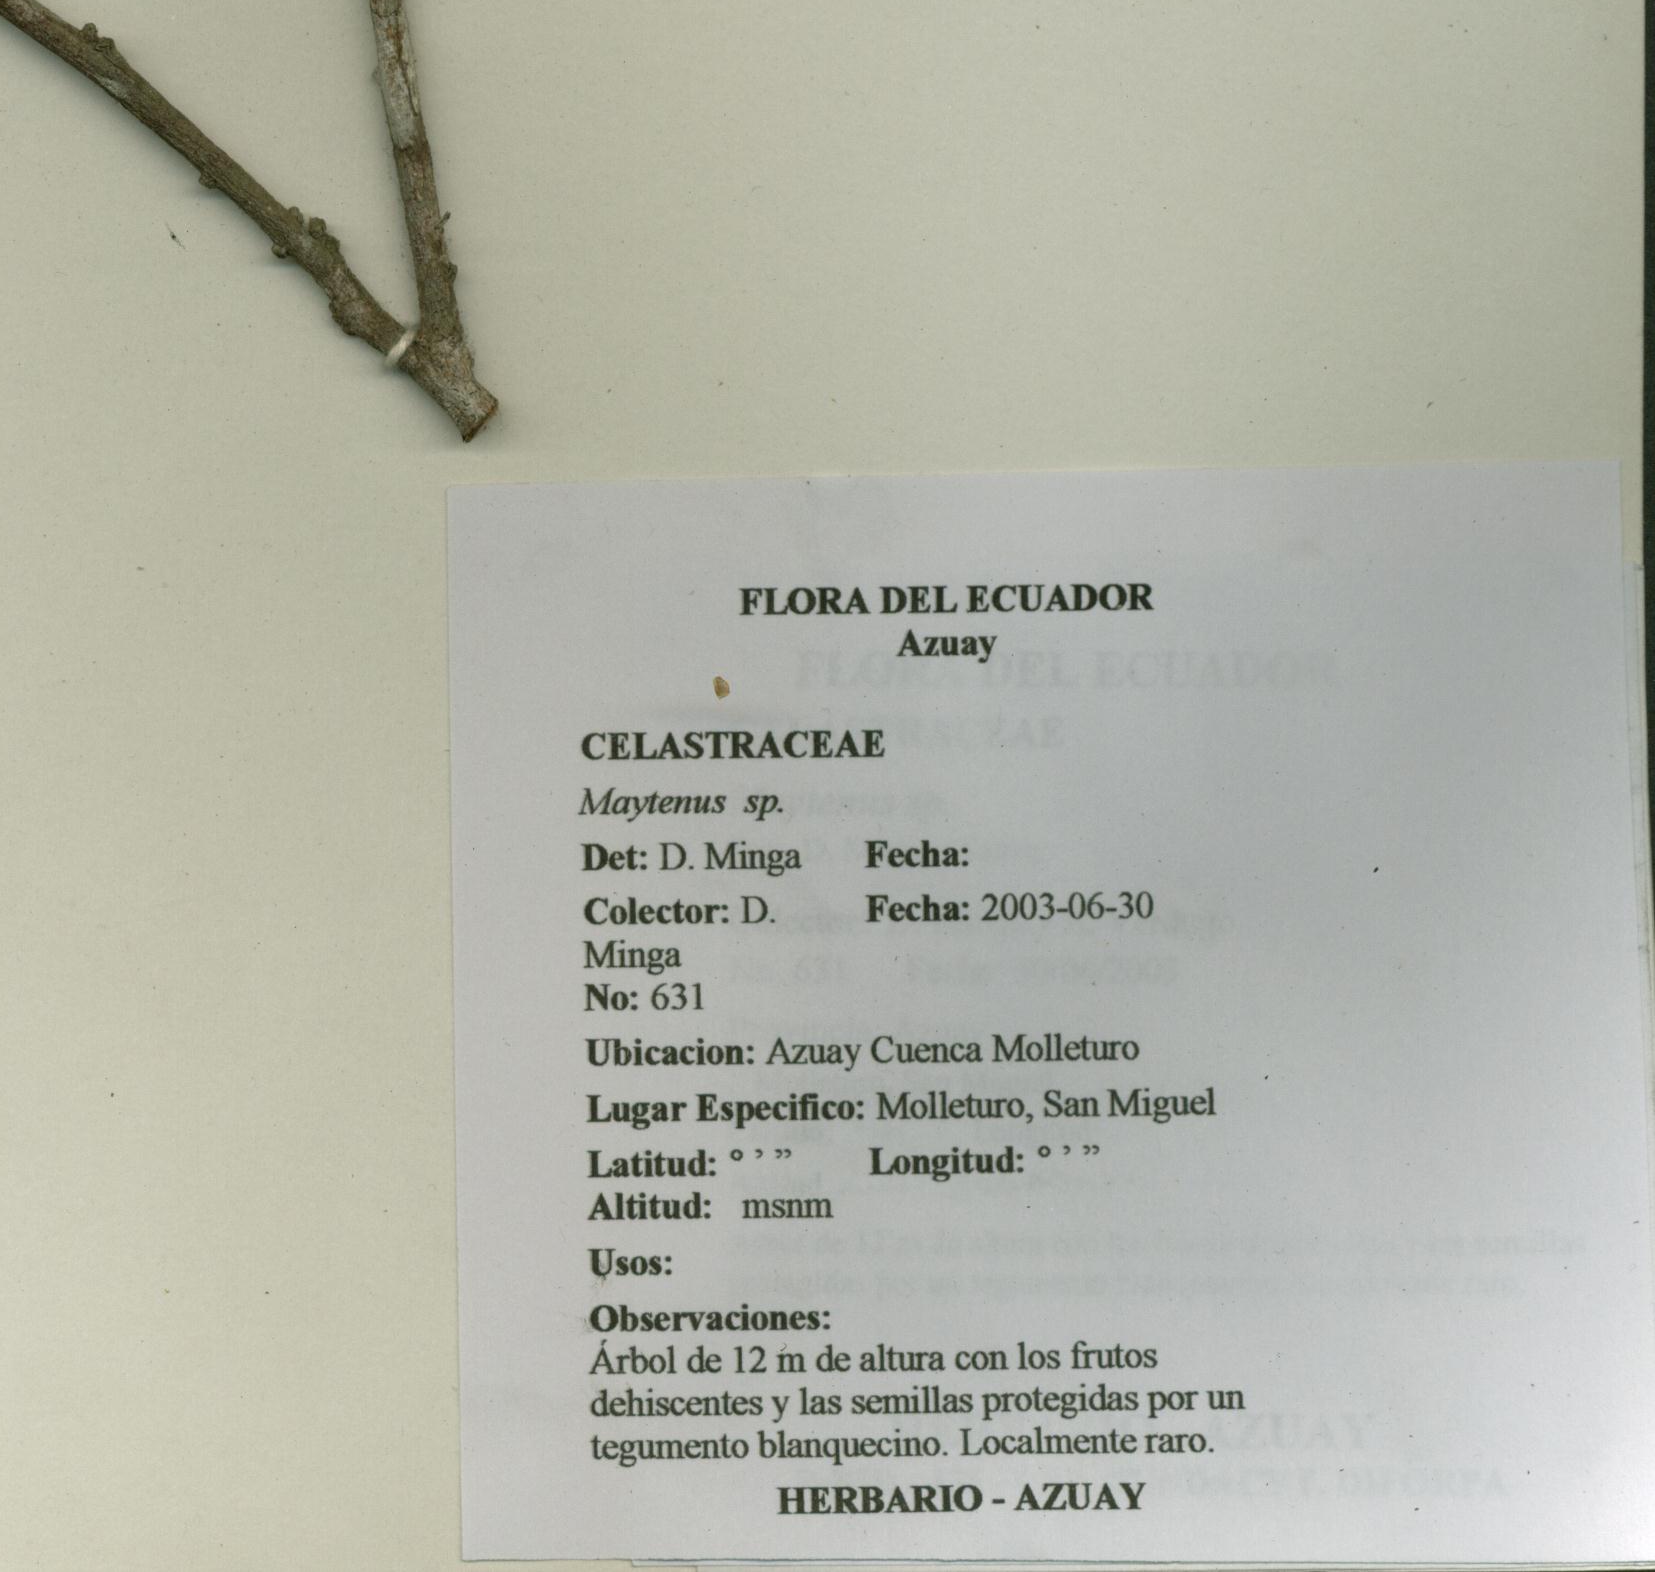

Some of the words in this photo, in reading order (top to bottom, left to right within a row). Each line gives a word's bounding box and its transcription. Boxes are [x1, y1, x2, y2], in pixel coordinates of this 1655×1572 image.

[738, 585, 871, 617] FLORA
[879, 584, 959, 616] DEL
[966, 582, 1155, 615] ECUADOR
[896, 627, 999, 664] Azuay
[580, 728, 887, 762] CELASTRACEAE
[577, 787, 728, 823] Maytenus
[742, 794, 785, 822] sp.
[580, 842, 648, 872] Det:
[658, 841, 695, 871] D.
[703, 840, 803, 878] Minga
[864, 839, 970, 869] Fecha:
[583, 896, 730, 926] Colector:
[740, 895, 776, 924] D.
[865, 893, 971, 923] Fecha:
[979, 890, 1155, 922] 2003-06-30
[582, 939, 683, 976] Minga
[584, 983, 639, 1012] No:
[650, 982, 705, 1010] 631
[584, 1037, 755, 1068] Ubicacion:
[765, 1036, 862, 1073] Azuay
[870, 1034, 984, 1064] Cuenca
[991, 1032, 1141, 1064] Molleturo
[586, 1094, 688, 1131] Lugar
[695, 1092, 866, 1131] Especifico:
[875, 1090, 1035, 1125] Molleturo,
[1043, 1090, 1099, 1119] San
[1107, 1086, 1217, 1123] Miguel
[587, 1148, 718, 1179] Latitud:
[868, 1145, 1025, 1183] Longitud:
[587, 1191, 712, 1222] Altitud:
[740, 1198, 834, 1220] msnm
[588, 1247, 674, 1278] Usos:
[589, 1303, 831, 1332] Observaciones:
[588, 1339, 679, 1375] Árbol
[686, 1344, 723, 1374] de
[733, 1345, 768, 1374] 12
[776, 1352, 808, 1374] m
[815, 1343, 852, 1373] de
[859, 1343, 946, 1373] altura
[954, 1350, 1009, 1371] con
[1017, 1341, 1061, 1370] los
[1071, 1340, 1158, 1370] frutos
[590, 1386, 764, 1418] dehiscentes
[770, 1397, 791, 1422] y
[799, 1386, 843, 1416] las
[851, 1385, 975, 1415] semillas
[981, 1382, 1140, 1422] protegidas
[1146, 1389, 1199, 1419] por
[1207, 1390, 1246, 1410] un
[590, 1434, 751, 1468] tegumento
[757, 1431, 949, 1466] blanquecino.
[958, 1425, 1139, 1456] Localmente
[1144, 1433, 1216, 1454] raro.
[776, 1484, 984, 1515] HERBARIO
[1013, 1481, 1147, 1512] AZUAY
